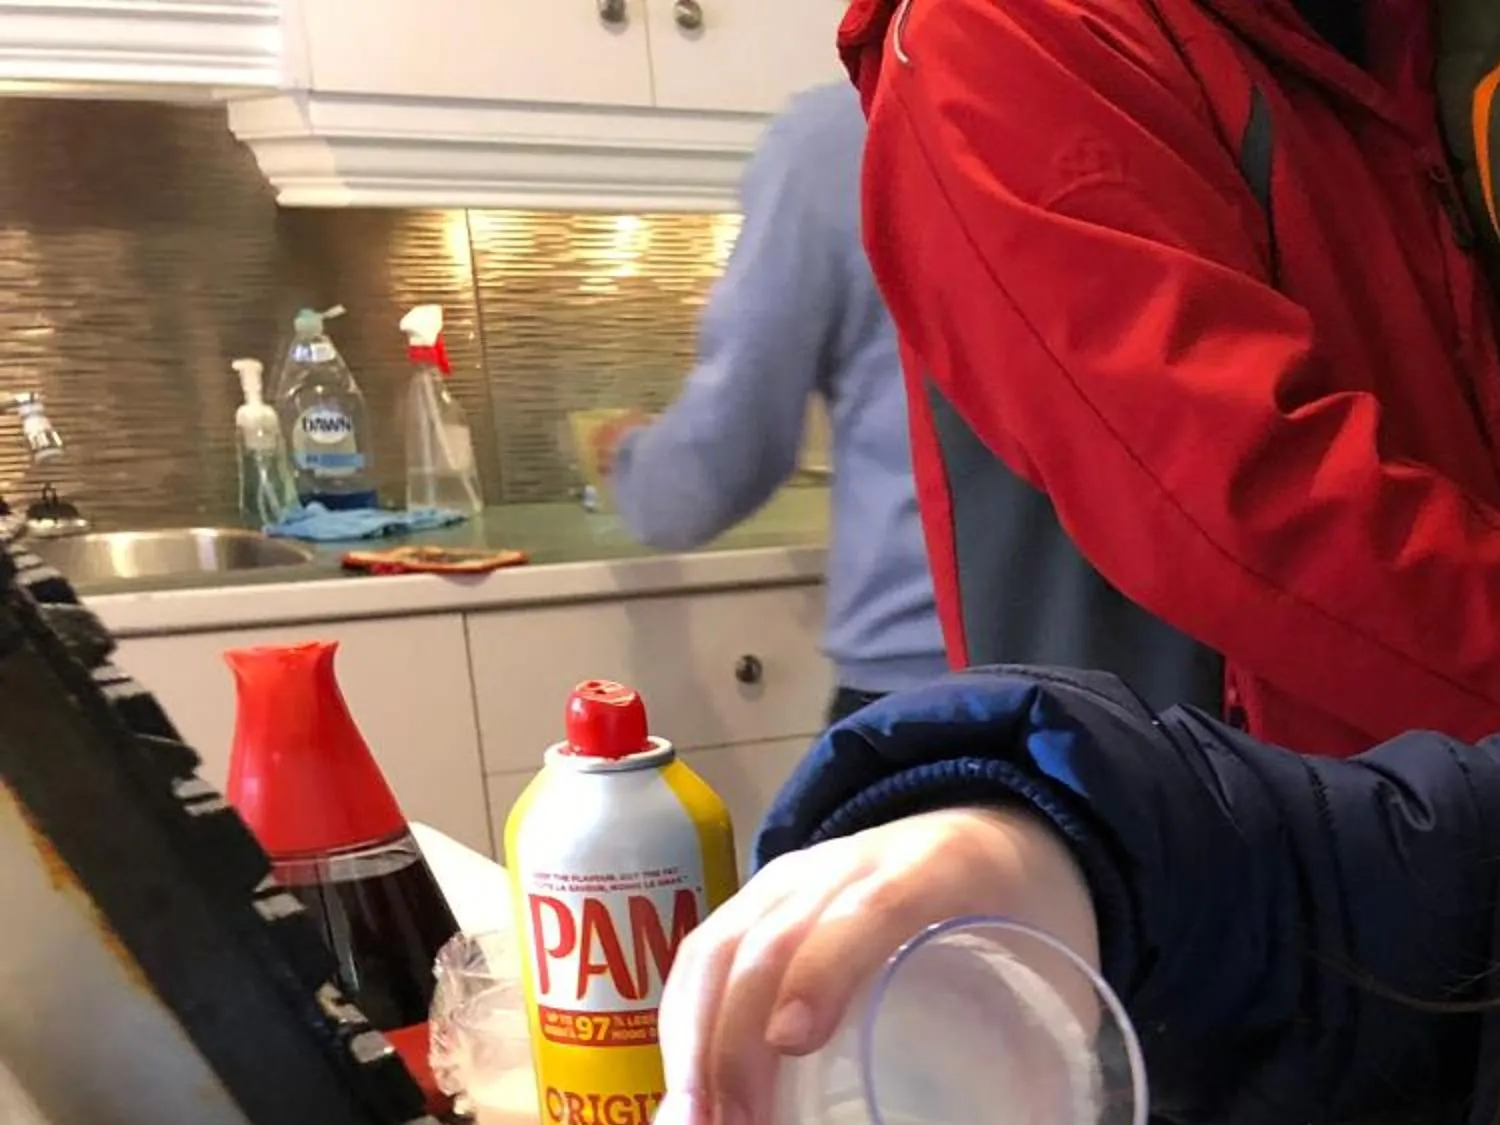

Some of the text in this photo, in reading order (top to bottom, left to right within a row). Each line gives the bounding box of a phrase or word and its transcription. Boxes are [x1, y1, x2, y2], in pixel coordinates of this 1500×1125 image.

[302, 415, 351, 432] DAWN
[528, 889, 698, 1000] PAM
[575, 1015, 611, 1041] 97
